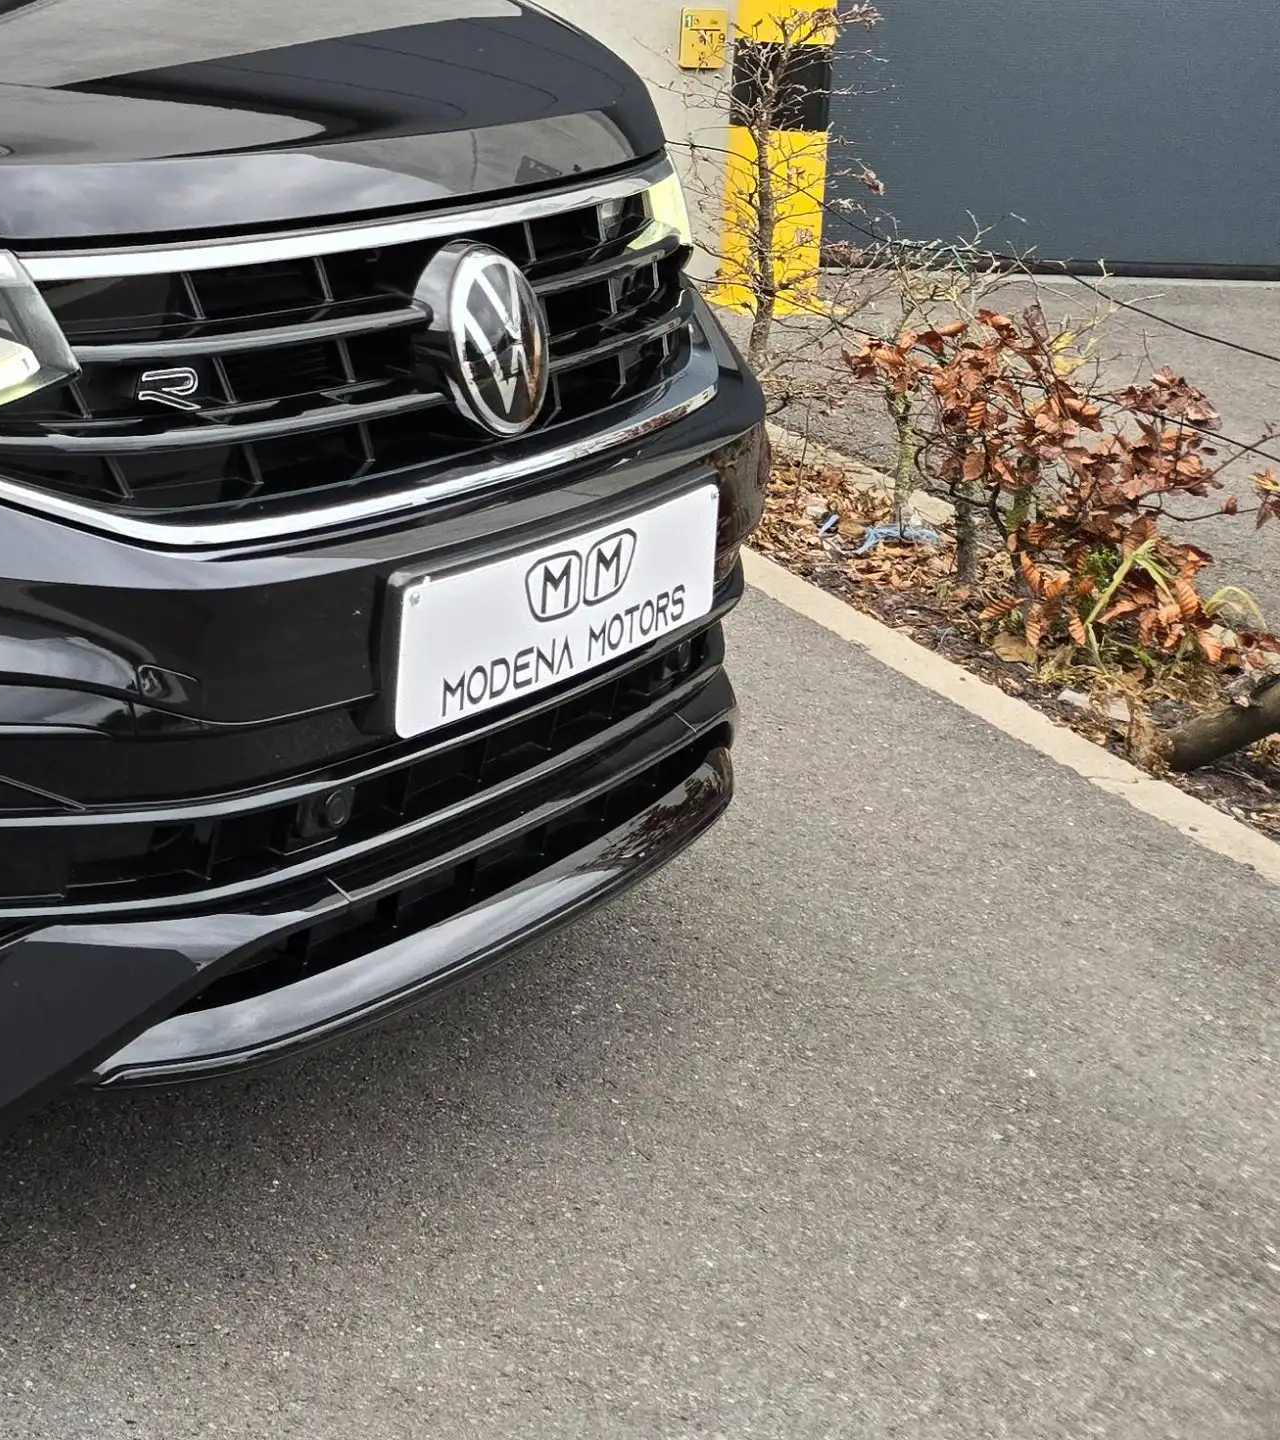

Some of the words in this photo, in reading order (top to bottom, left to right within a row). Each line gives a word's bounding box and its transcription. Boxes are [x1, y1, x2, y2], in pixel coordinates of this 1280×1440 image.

[137, 366, 202, 410] R
[440, 635, 574, 718] MODENA
[587, 583, 687, 662] MOTORS
